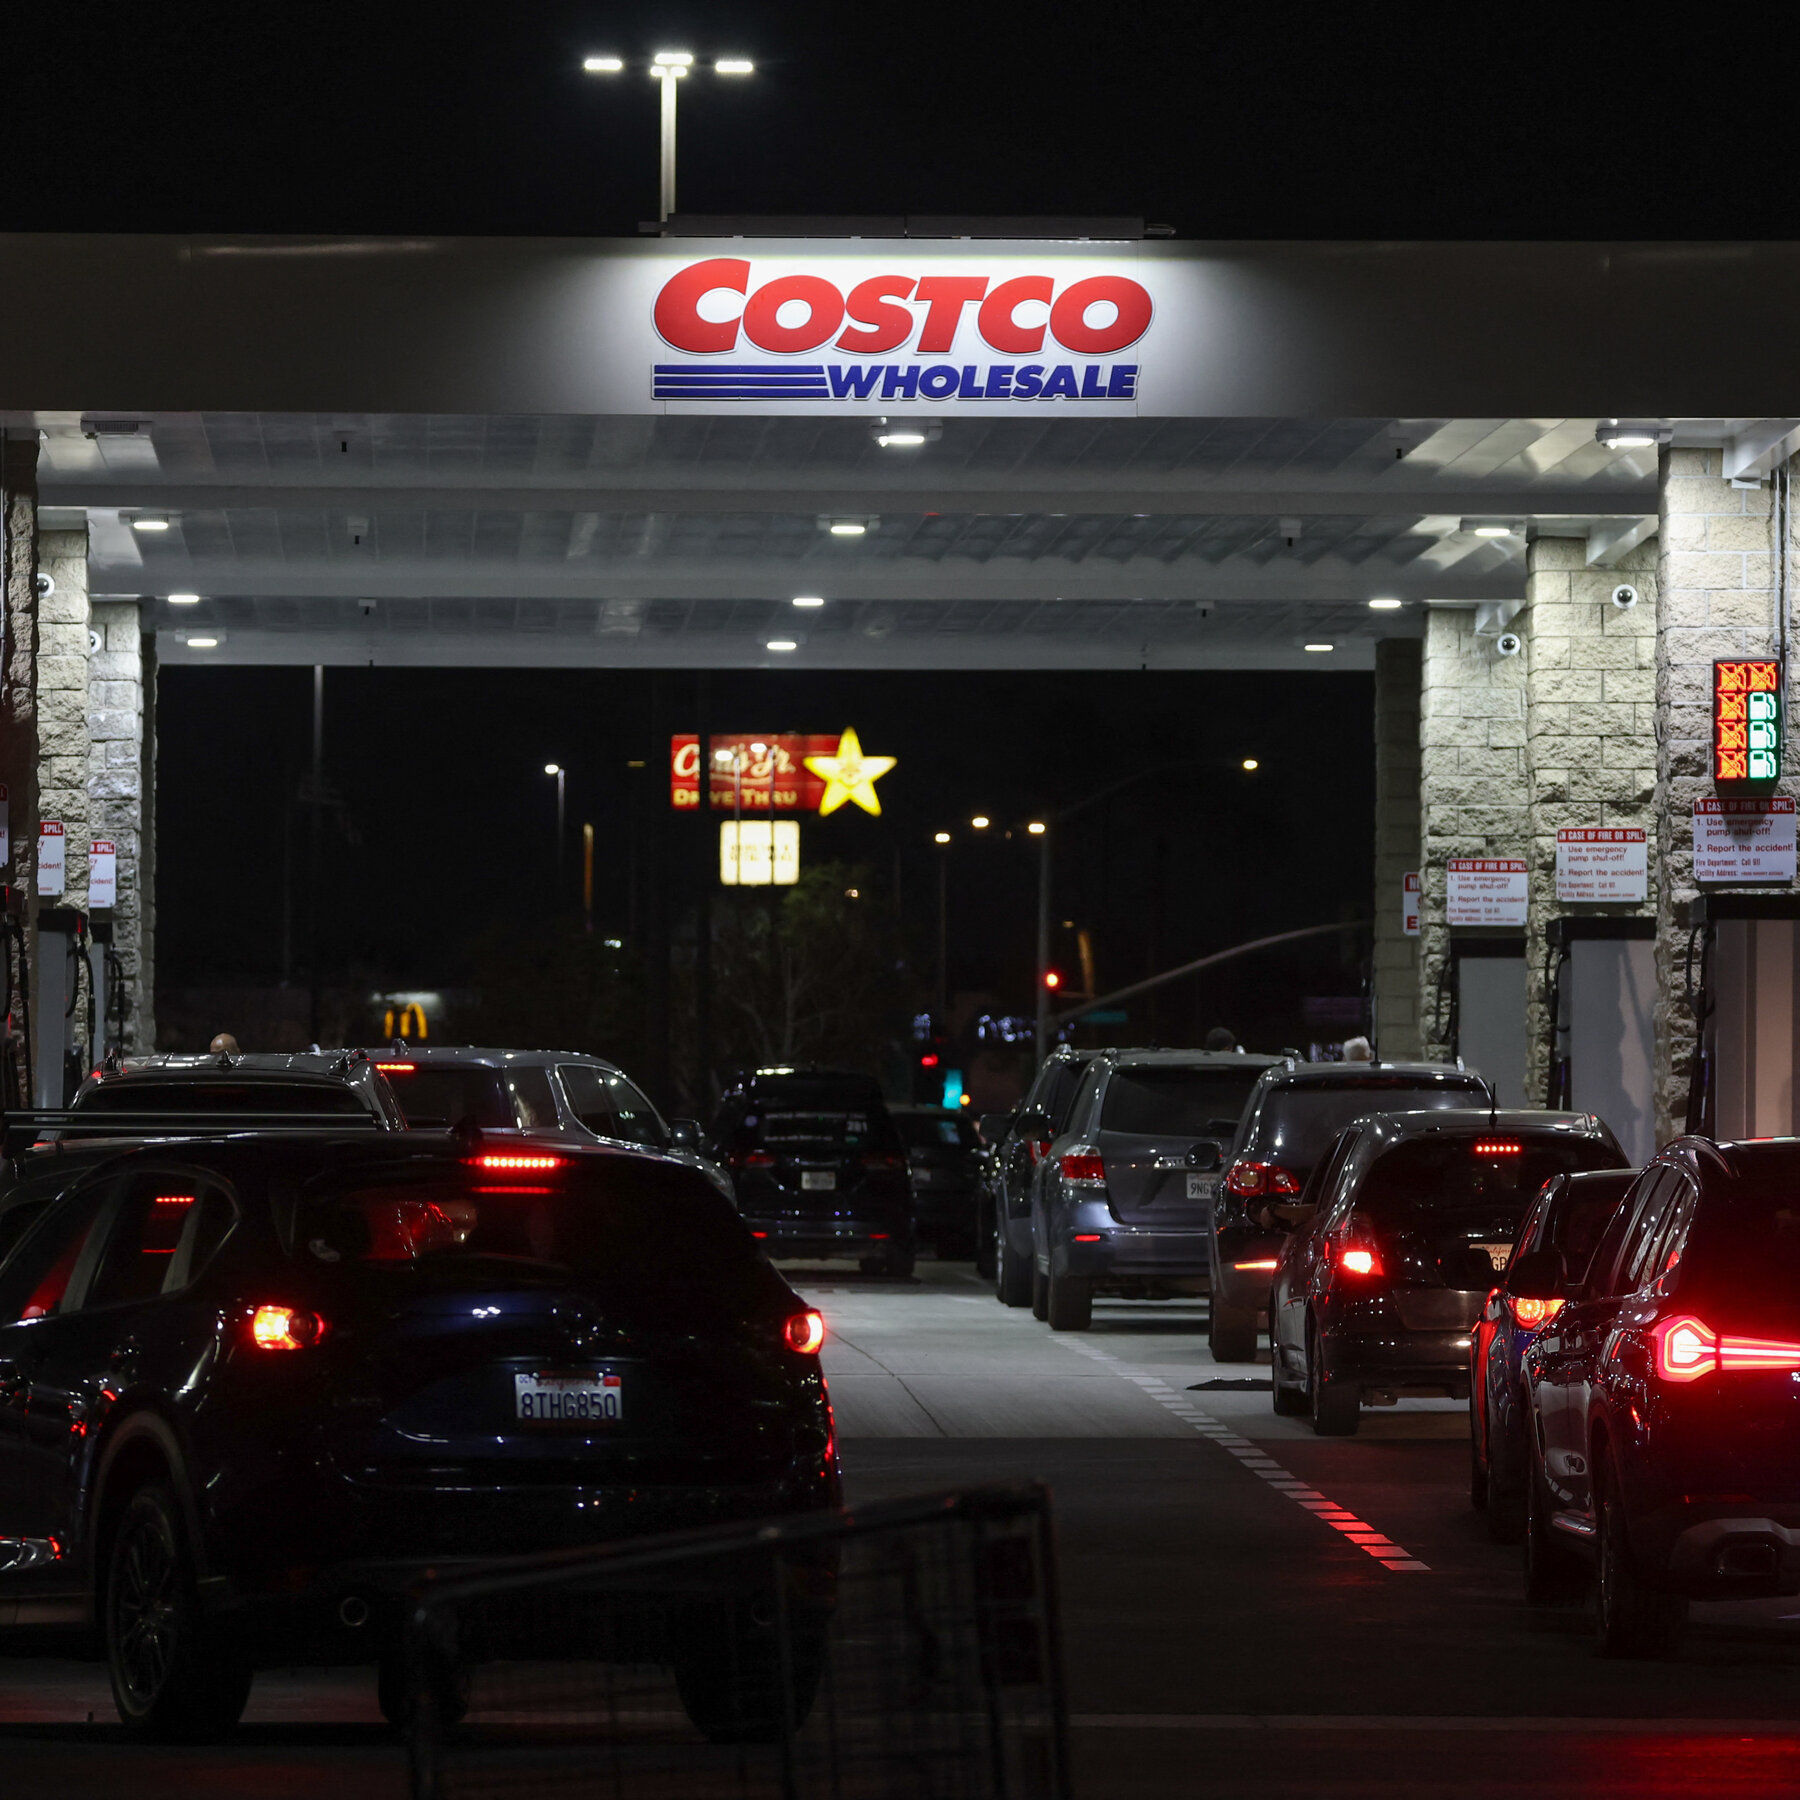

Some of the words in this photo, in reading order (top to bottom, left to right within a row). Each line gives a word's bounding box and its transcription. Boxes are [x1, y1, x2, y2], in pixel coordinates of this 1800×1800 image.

[653, 257, 1153, 355] COSTCO
[827, 364, 1139, 399] WHOLESALE
[673, 788, 735, 806] DRVE
[1696, 801, 1704, 812] IN
[1772, 800, 1793, 811] SPILL
[1697, 818, 1703, 826] 1.
[1706, 818, 1723, 826] Use
[1726, 819, 1774, 827] emergency
[44, 824, 62, 833] SPILL
[1706, 828, 1730, 837] pump
[1559, 831, 1566, 840] IN
[1568, 831, 1585, 840] CASE
[1587, 831, 1596, 840] OF
[1598, 831, 1612, 840] FIRE
[1615, 831, 1624, 840] OR
[1627, 831, 1644, 840] SPILL
[97, 844, 114, 853] SPILL
[1696, 844, 1704, 852] 2.
[1707, 844, 1735, 853] Report
[1739, 844, 1752, 852] the
[1755, 843, 1793, 852] accident!
[1459, 862, 1473, 870] CASE
[1475, 862, 1483, 870] OF
[1485, 862, 1497, 870] FIRE
[1500, 862, 1508, 870] OR
[1510, 862, 1526, 870] SPILL
[1741, 858, 1752, 866] Call
[1568, 869, 1593, 877] Report
[521, 1393, 616, 1418] 8THG850
